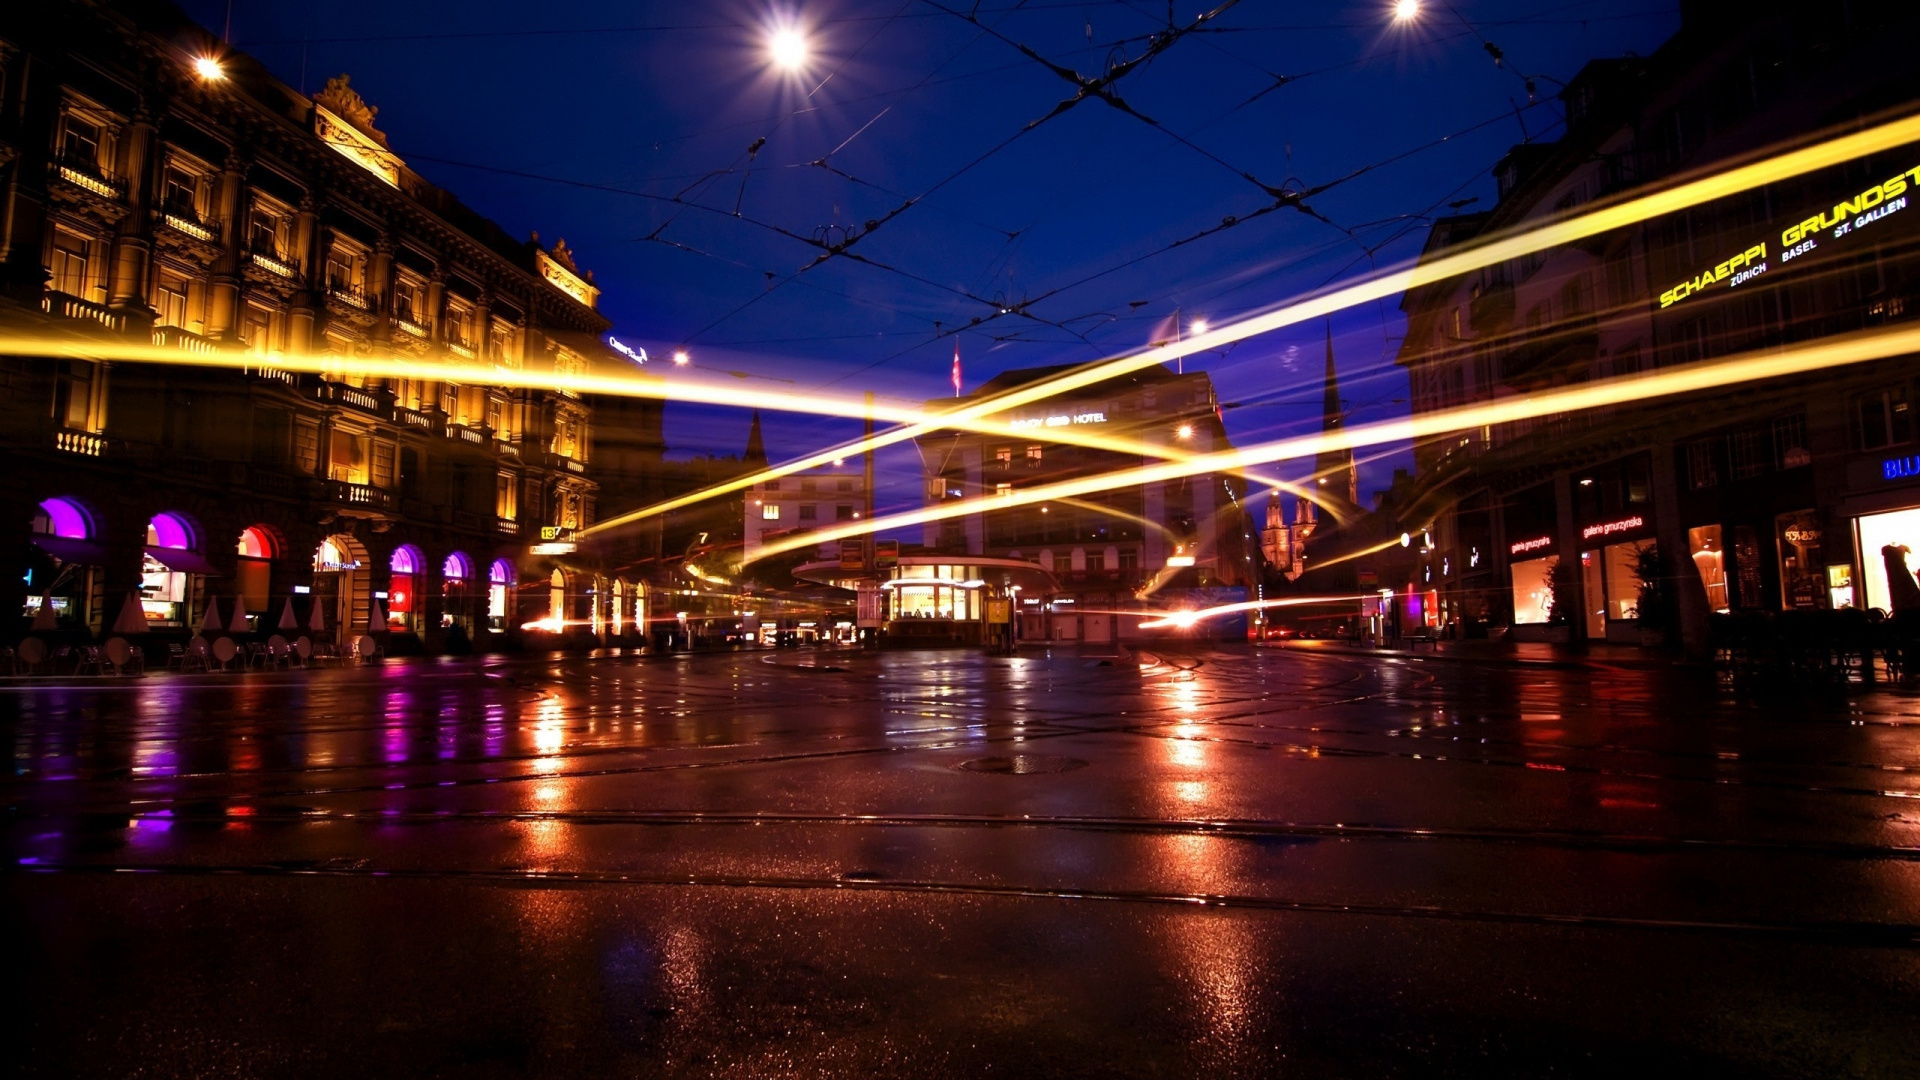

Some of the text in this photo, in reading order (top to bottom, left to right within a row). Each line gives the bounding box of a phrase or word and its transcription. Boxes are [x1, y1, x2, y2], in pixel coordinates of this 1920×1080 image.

[1730, 197, 1907, 287] ZÜRICH BASEL ST. GALLEN
[1660, 242, 1767, 309] SCHAEPPI
[1074, 413, 1107, 424] HOTEL
[542, 526, 562, 539] 13 7
[1583, 516, 1643, 539] galerie gmurzynska
[699, 532, 708, 544] 7
